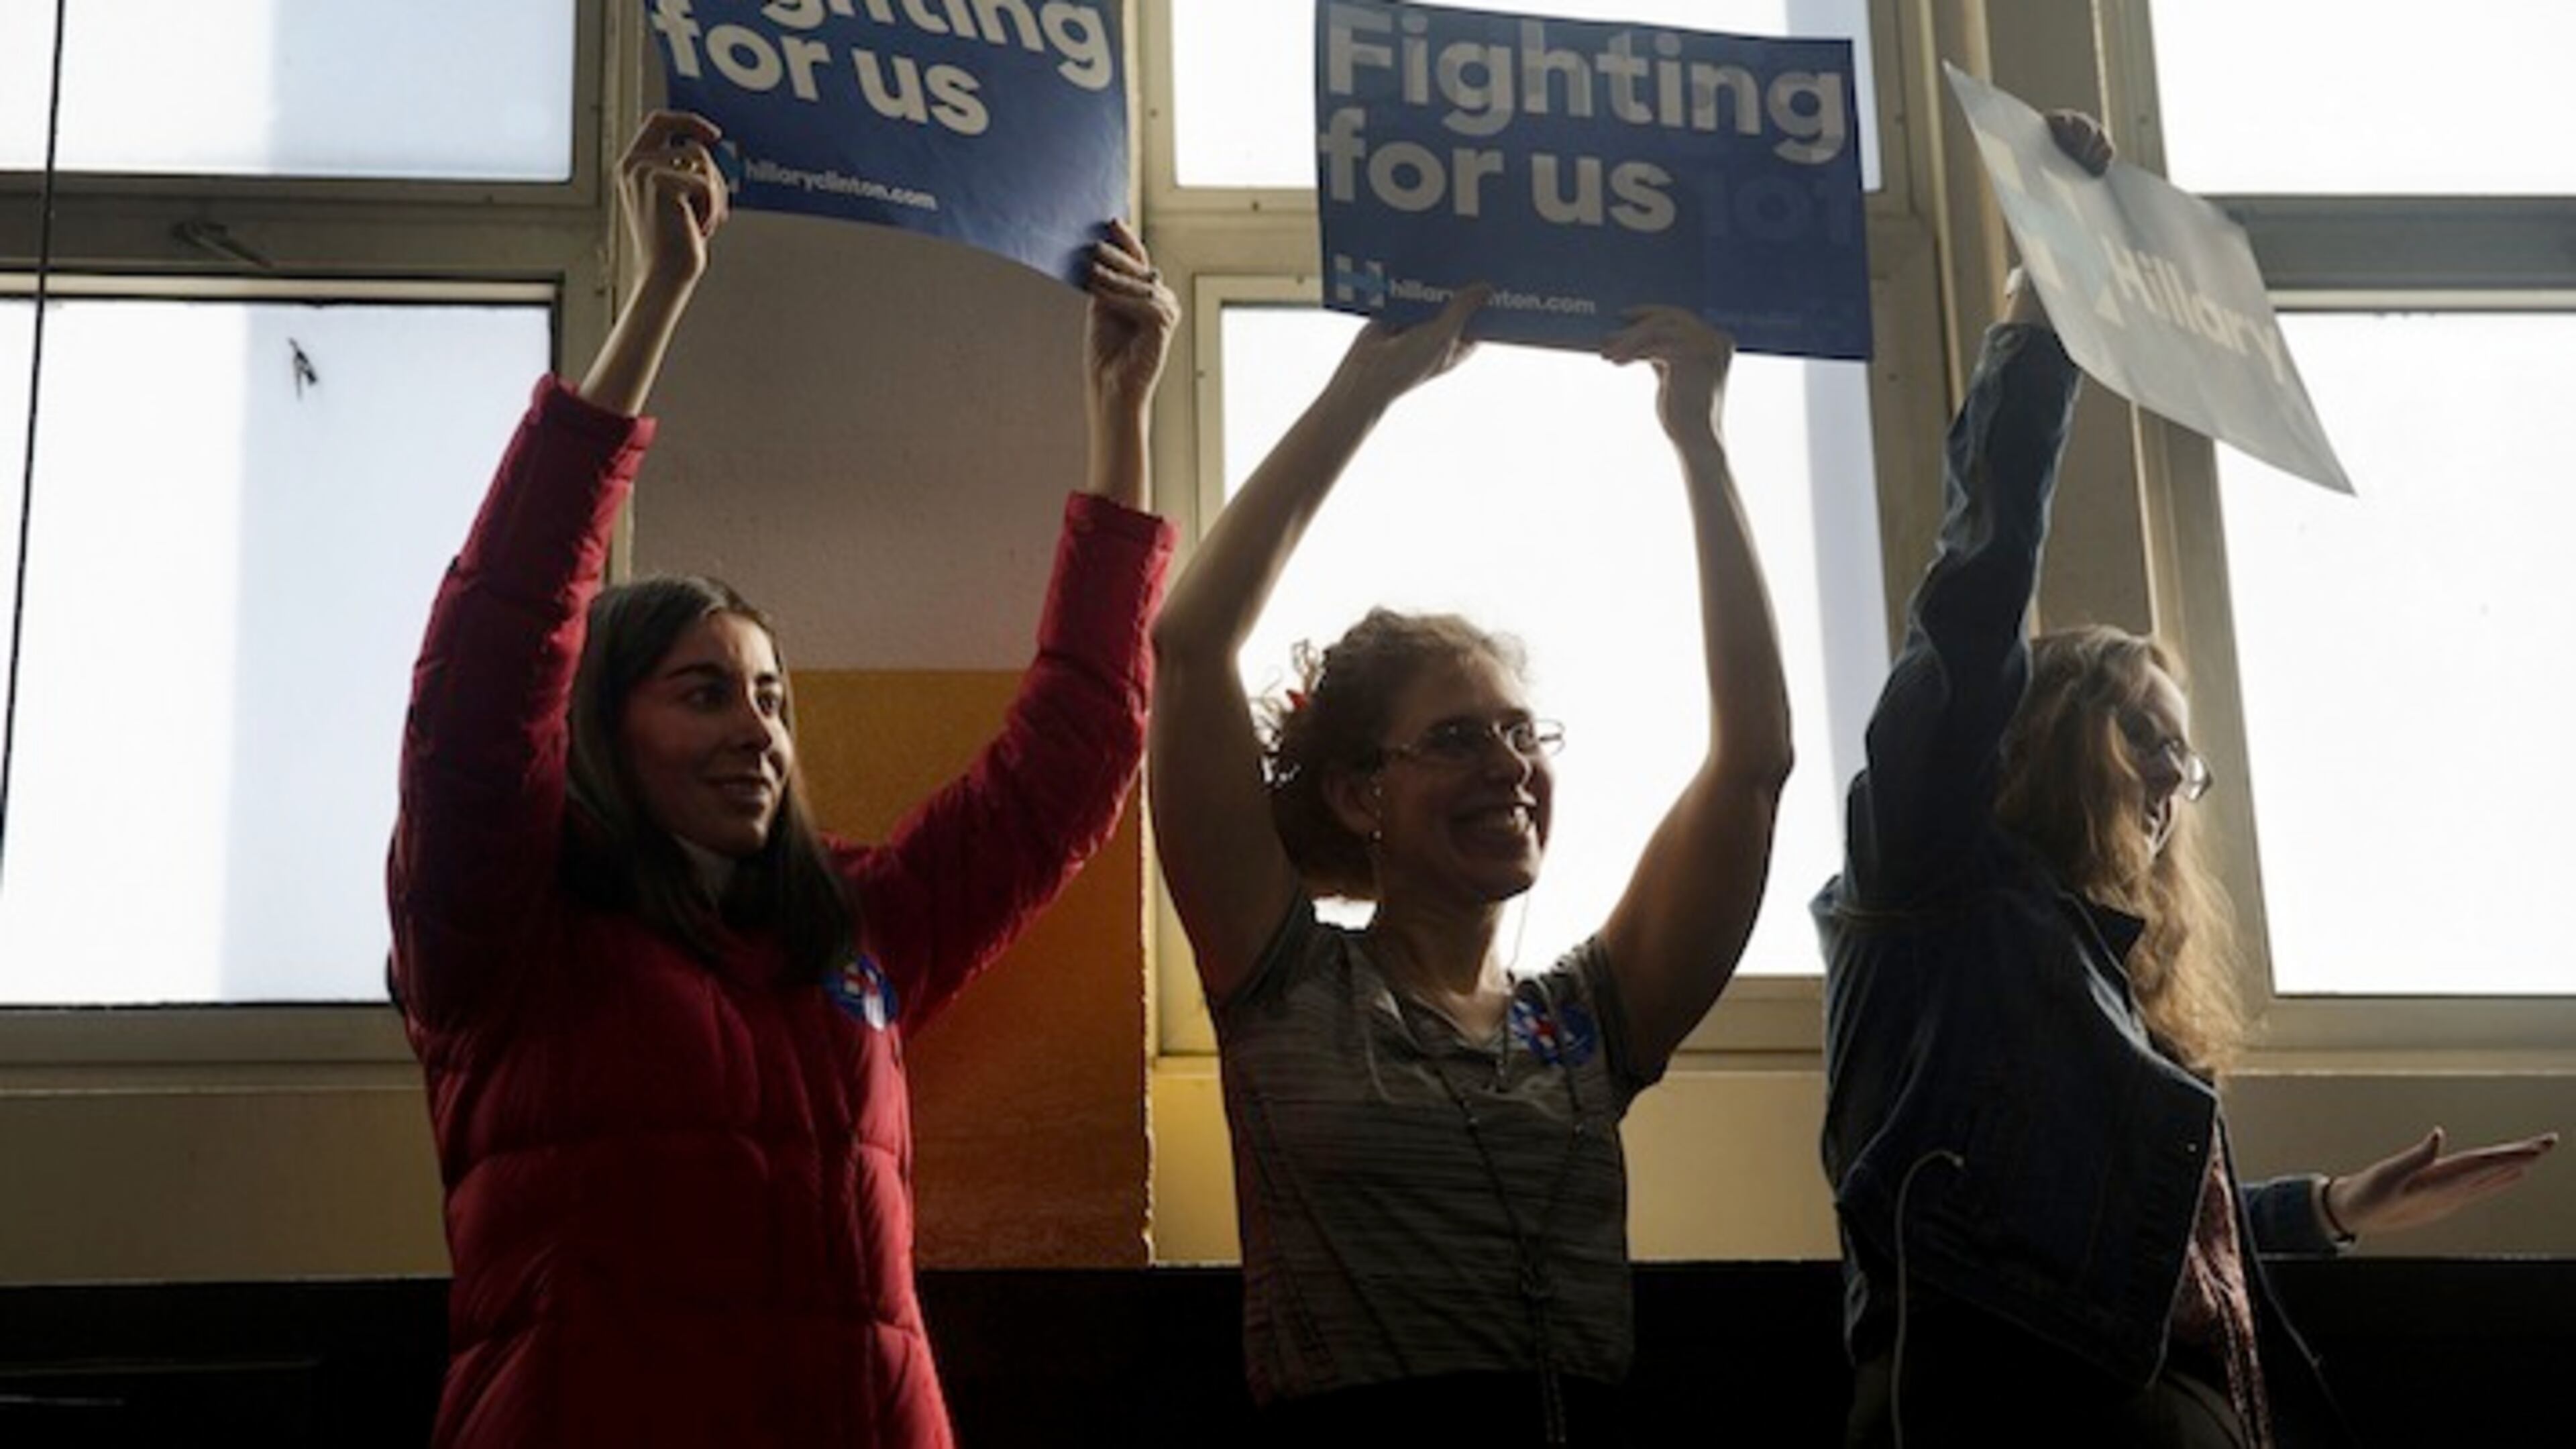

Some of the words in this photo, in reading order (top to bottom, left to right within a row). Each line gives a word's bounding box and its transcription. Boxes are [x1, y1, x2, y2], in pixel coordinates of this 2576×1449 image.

[652, 0, 832, 101] for
[851, 49, 989, 134] us
[1327, 7, 1846, 164] Fighting
[746, 157, 938, 211] hillaryclinton.com
[1318, 108, 1504, 217] for
[1530, 151, 1677, 233] us
[2100, 235, 2284, 385] Hillary
